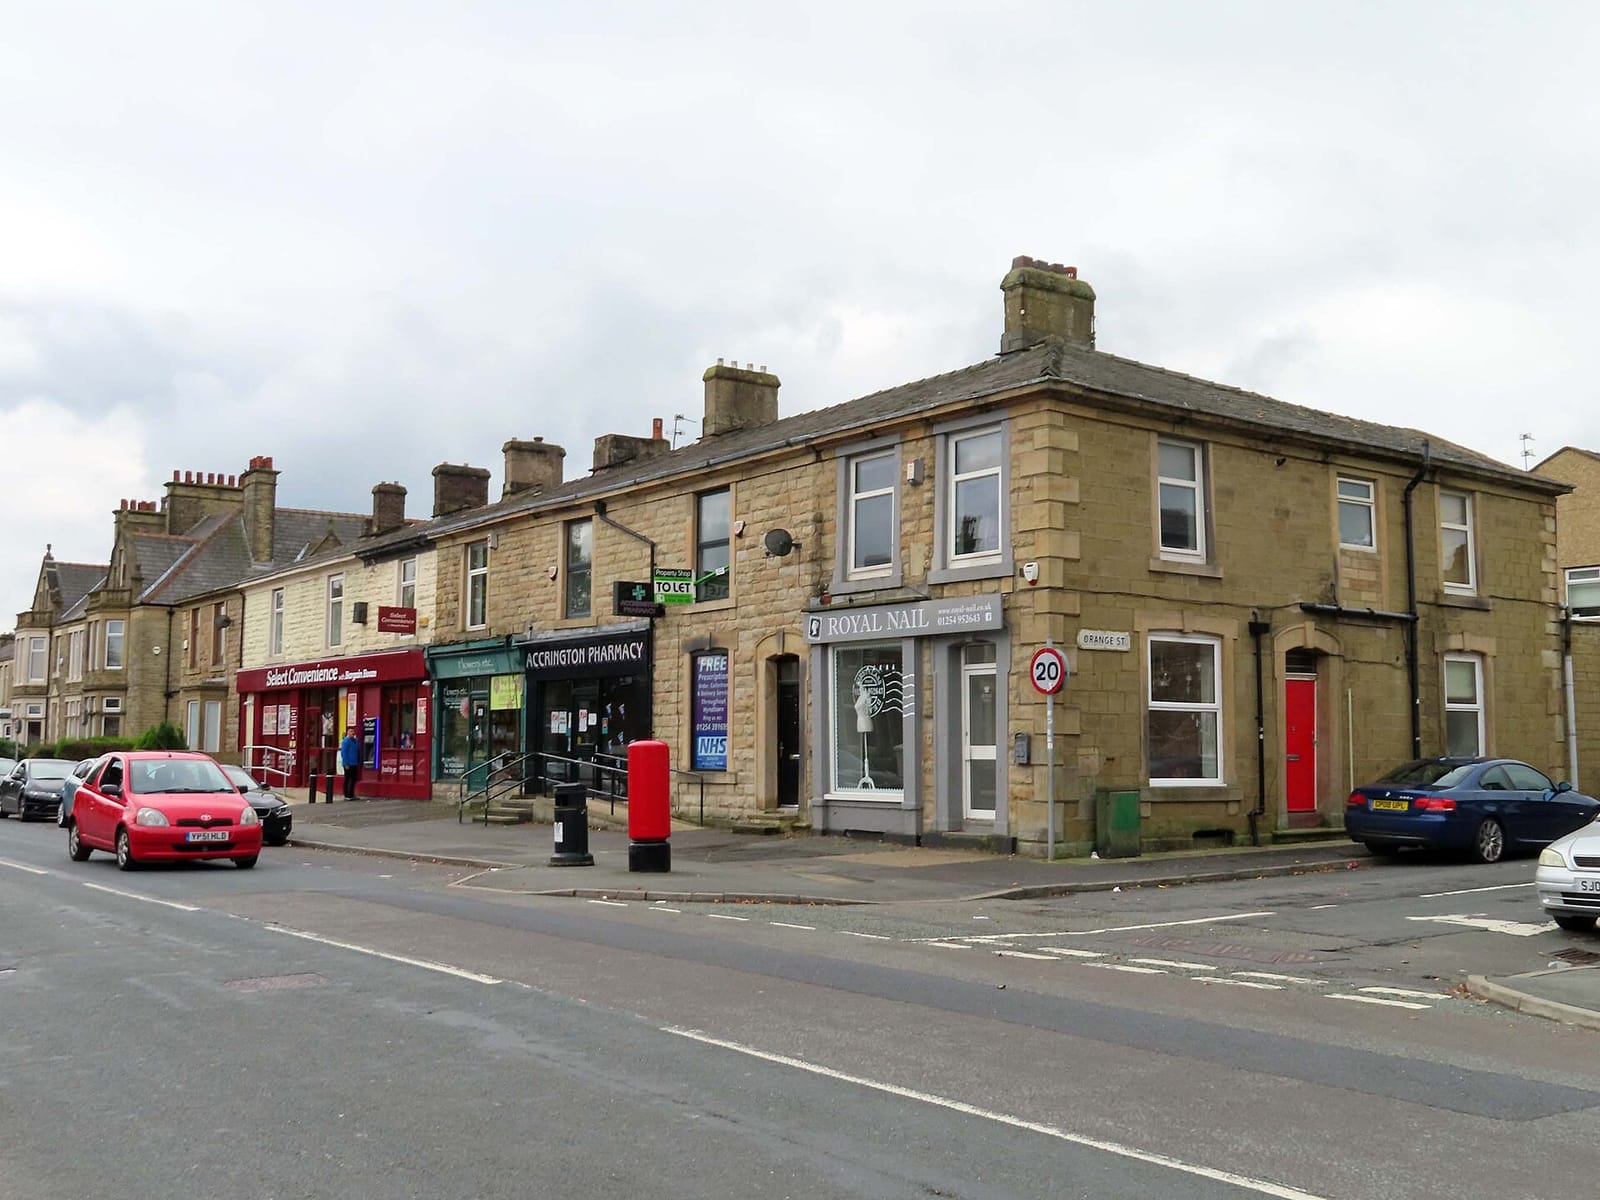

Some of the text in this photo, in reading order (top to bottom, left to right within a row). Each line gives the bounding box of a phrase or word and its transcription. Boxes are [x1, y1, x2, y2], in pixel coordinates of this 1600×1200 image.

[655, 569, 691, 577] Property Shop
[656, 582, 690, 593] TO LET
[828, 608, 930, 636] ROYAL NAIL
[938, 615, 957, 625] 01254
[957, 613, 981, 624] 952643
[1083, 635, 1126, 646] ORANGE ST
[526, 642, 643, 668] ACCRINGTON PHARMACY
[699, 655, 727, 672] FREE
[1036, 662, 1059, 680] 20
[266, 668, 288, 687] Select
[288, 663, 339, 685] Convenience
[696, 723, 711, 731] 01254
[699, 738, 727, 754] NHS
